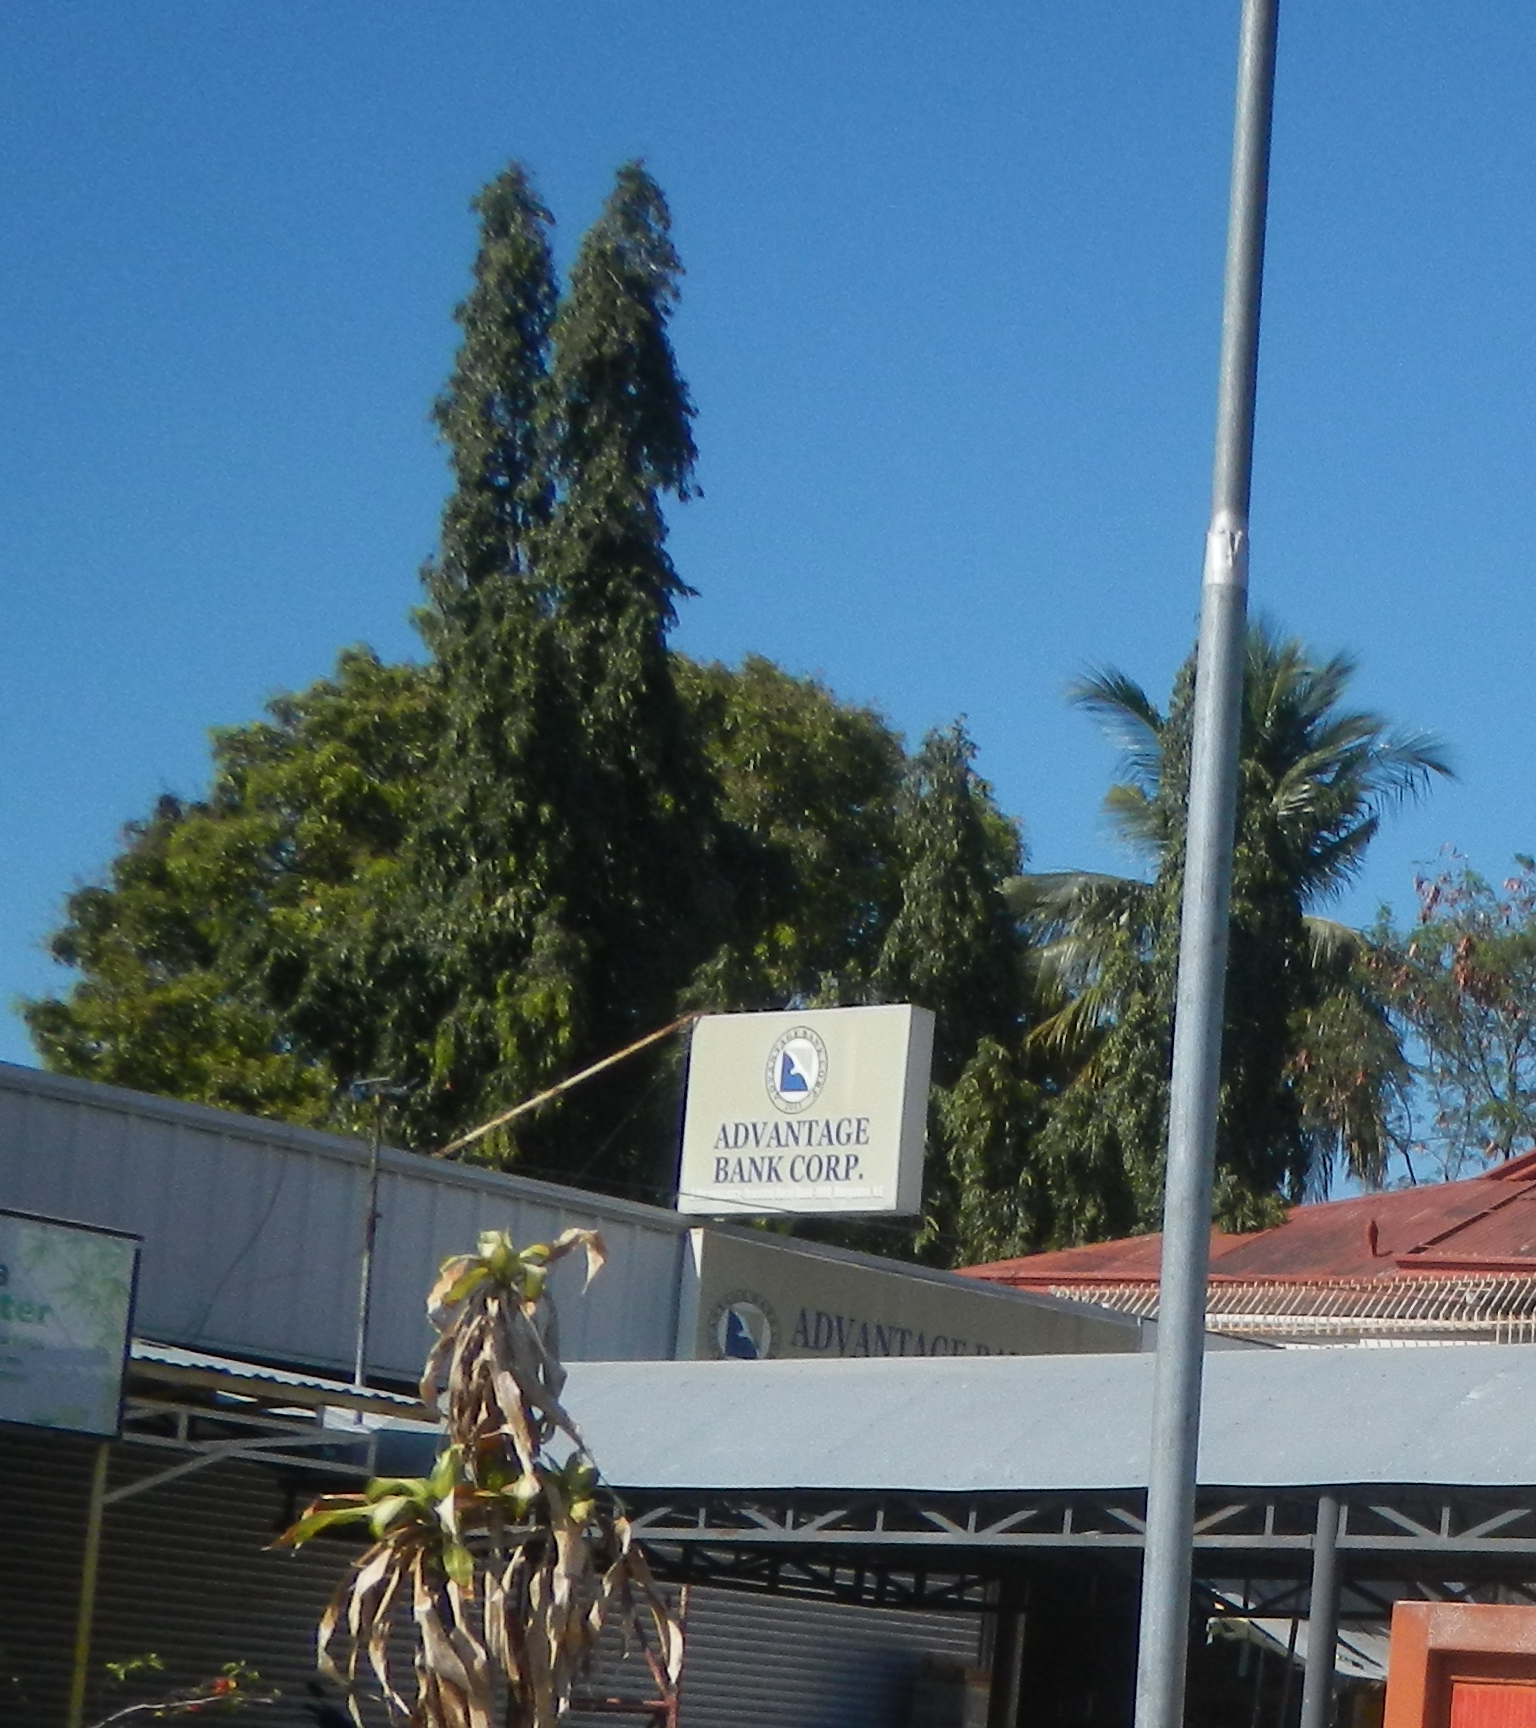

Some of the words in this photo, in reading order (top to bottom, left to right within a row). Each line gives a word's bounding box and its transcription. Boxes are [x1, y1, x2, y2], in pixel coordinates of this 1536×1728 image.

[714, 1117, 870, 1149] ADVANTAGE
[714, 1156, 784, 1184] BANK
[789, 1154, 864, 1183] CORP.
